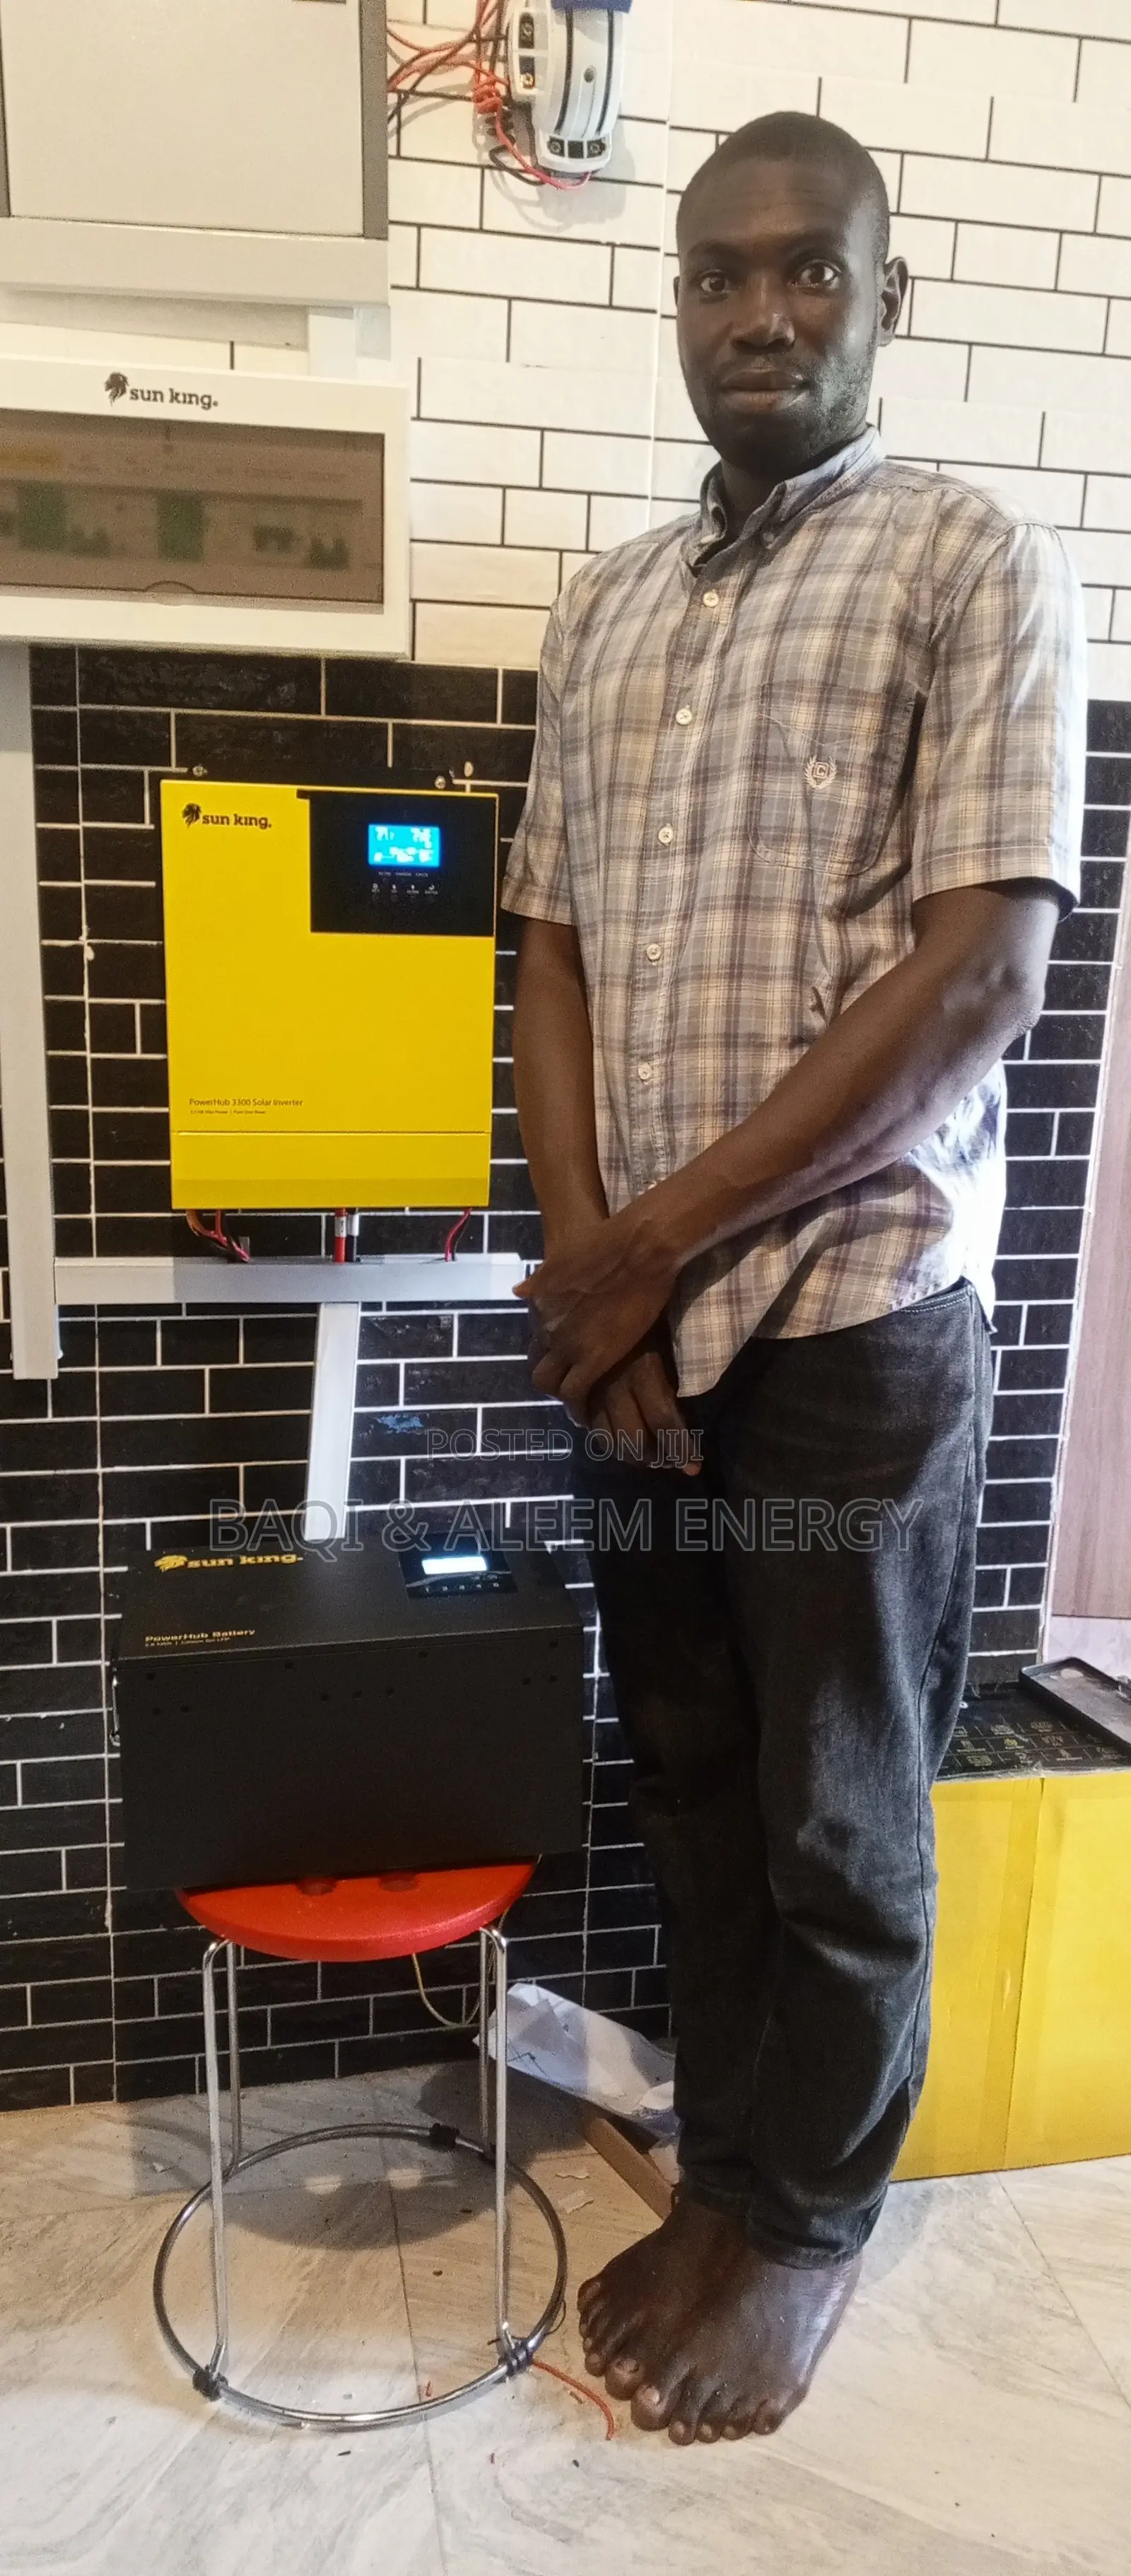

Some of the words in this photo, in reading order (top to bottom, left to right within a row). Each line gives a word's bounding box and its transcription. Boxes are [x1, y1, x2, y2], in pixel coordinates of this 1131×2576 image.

[129, 388, 164, 403] sun
[202, 814, 229, 826] sun
[189, 1098, 230, 1106] PowerHub
[187, 1558, 234, 1569] sun
[144, 1633, 209, 1642] PowerHub
[211, 1629, 256, 1638] Battery
